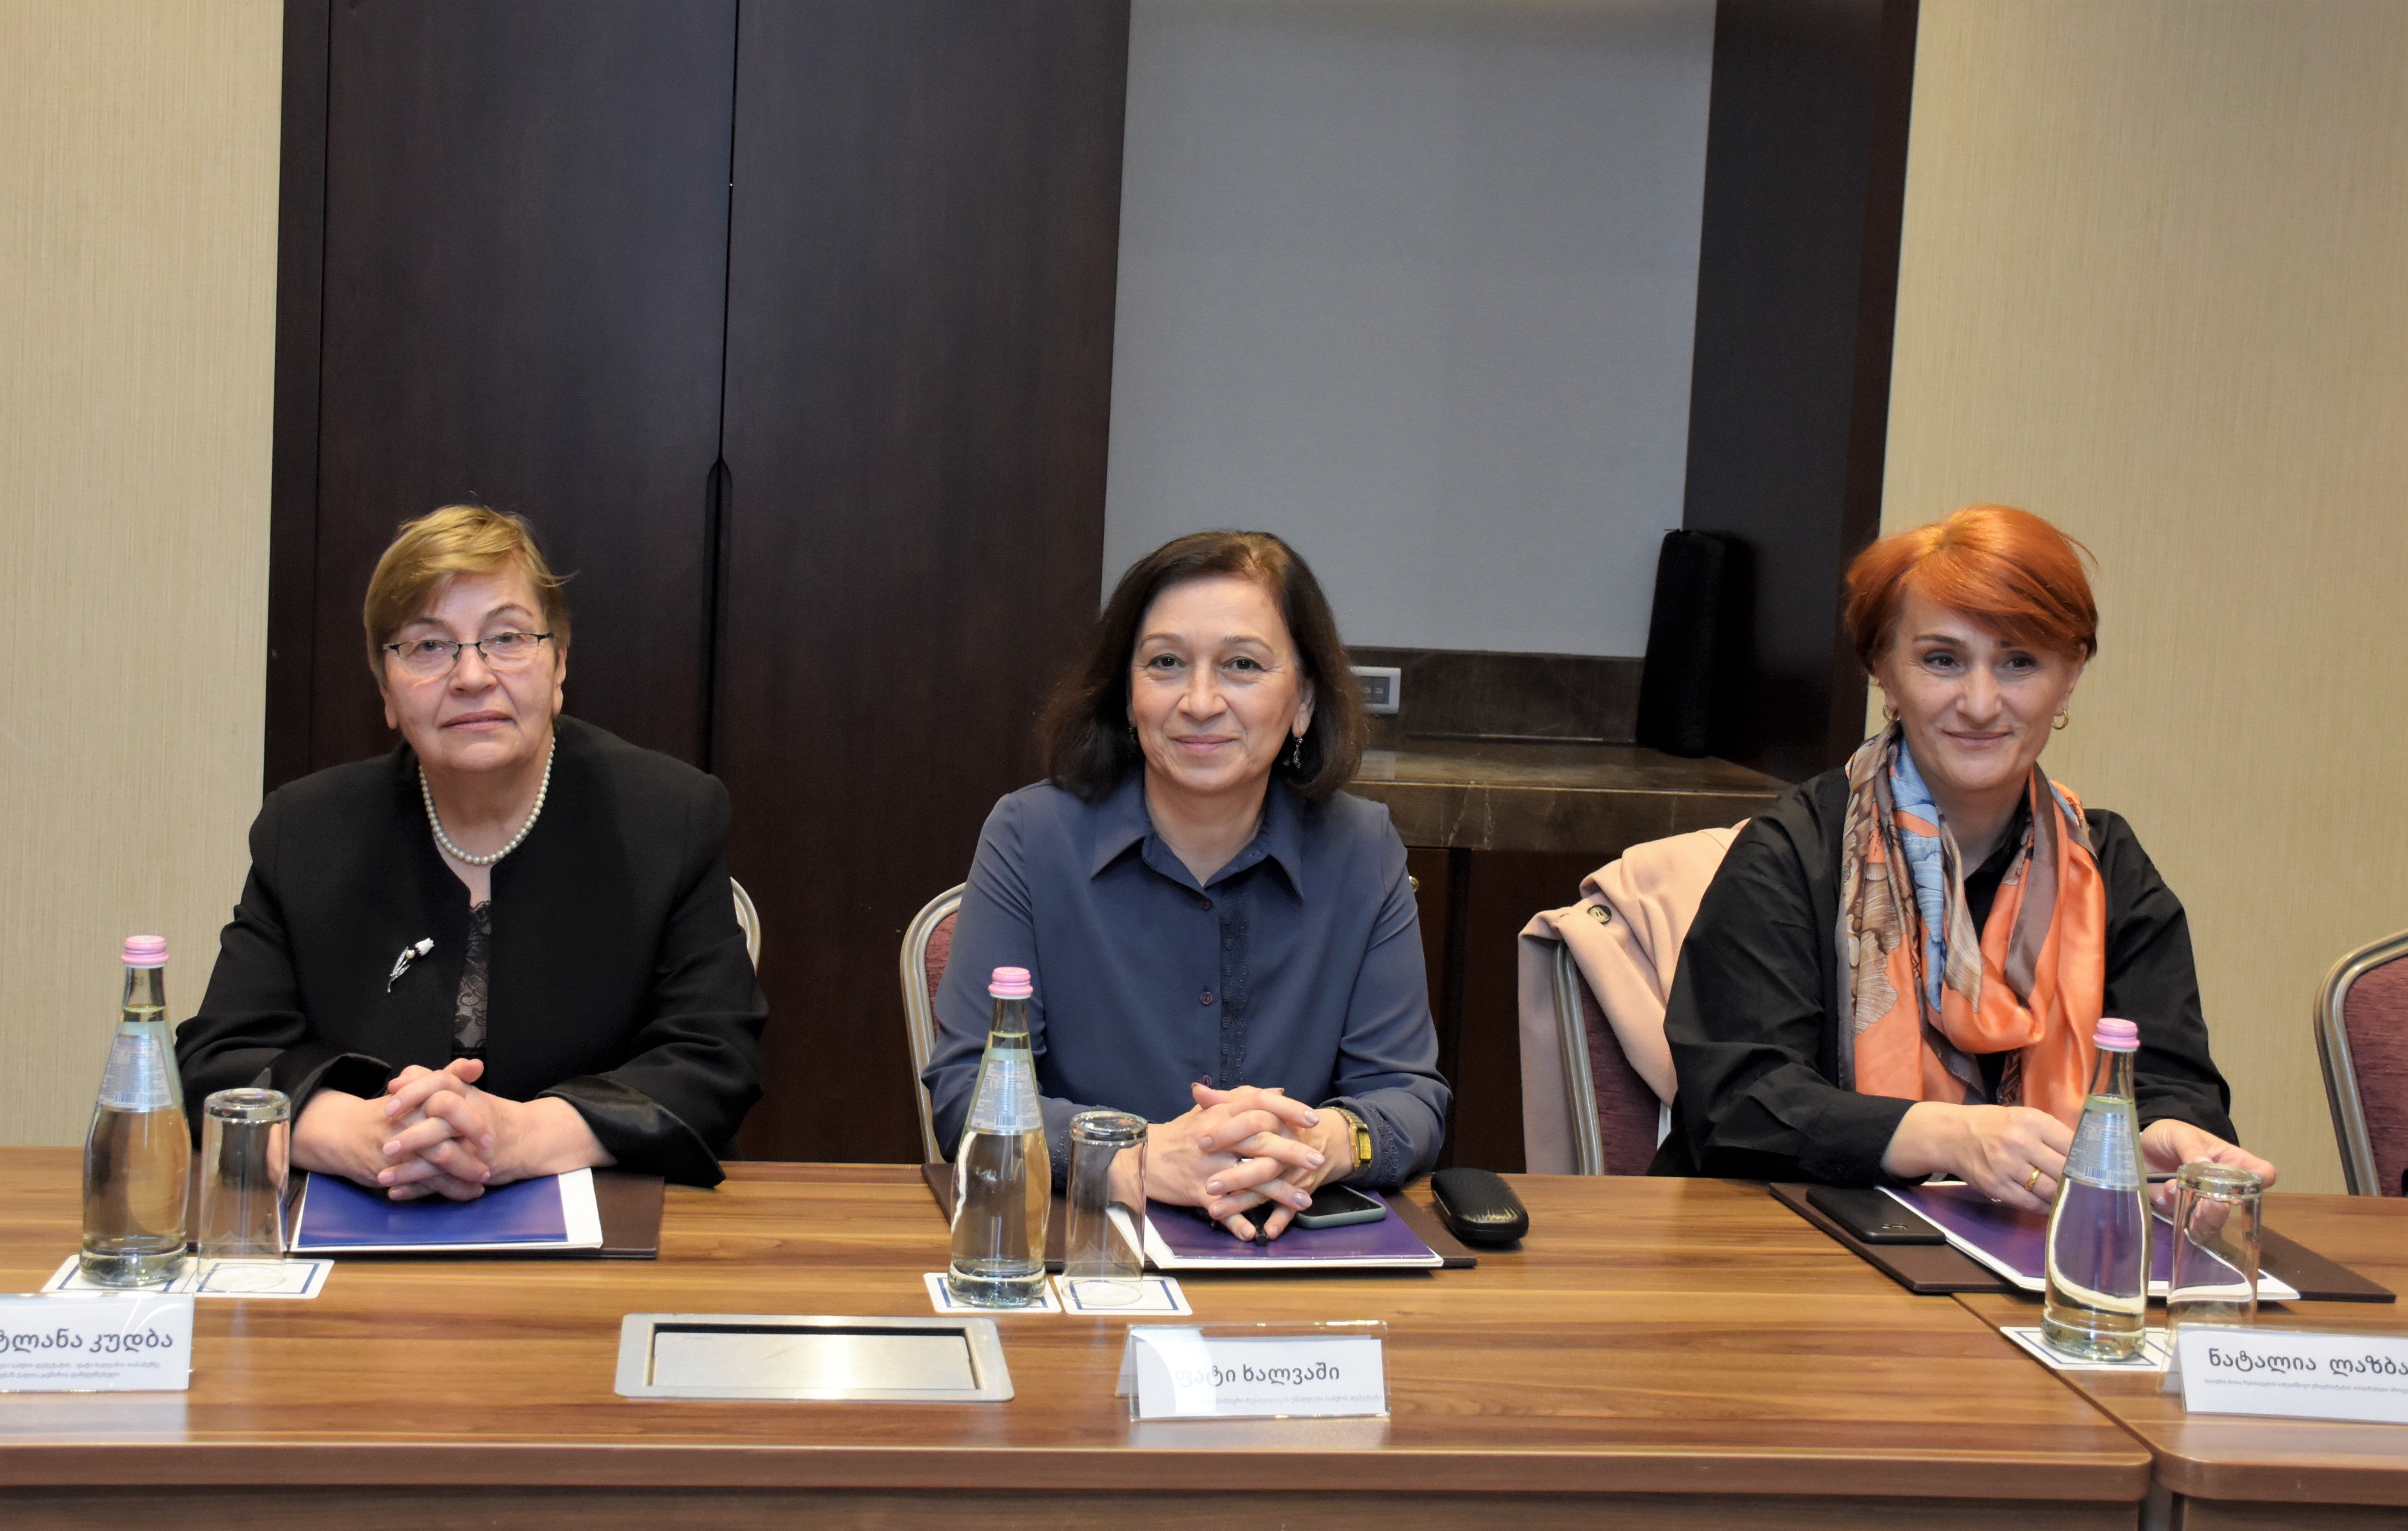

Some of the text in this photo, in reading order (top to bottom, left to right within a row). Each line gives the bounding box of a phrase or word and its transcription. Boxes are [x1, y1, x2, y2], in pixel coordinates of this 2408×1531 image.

[90, 1328, 173, 1353] კუდბა
[2208, 1347, 2408, 1377] ნატალია ლაზბა
[1175, 1363, 1340, 1388] ფატი ხალვაში
